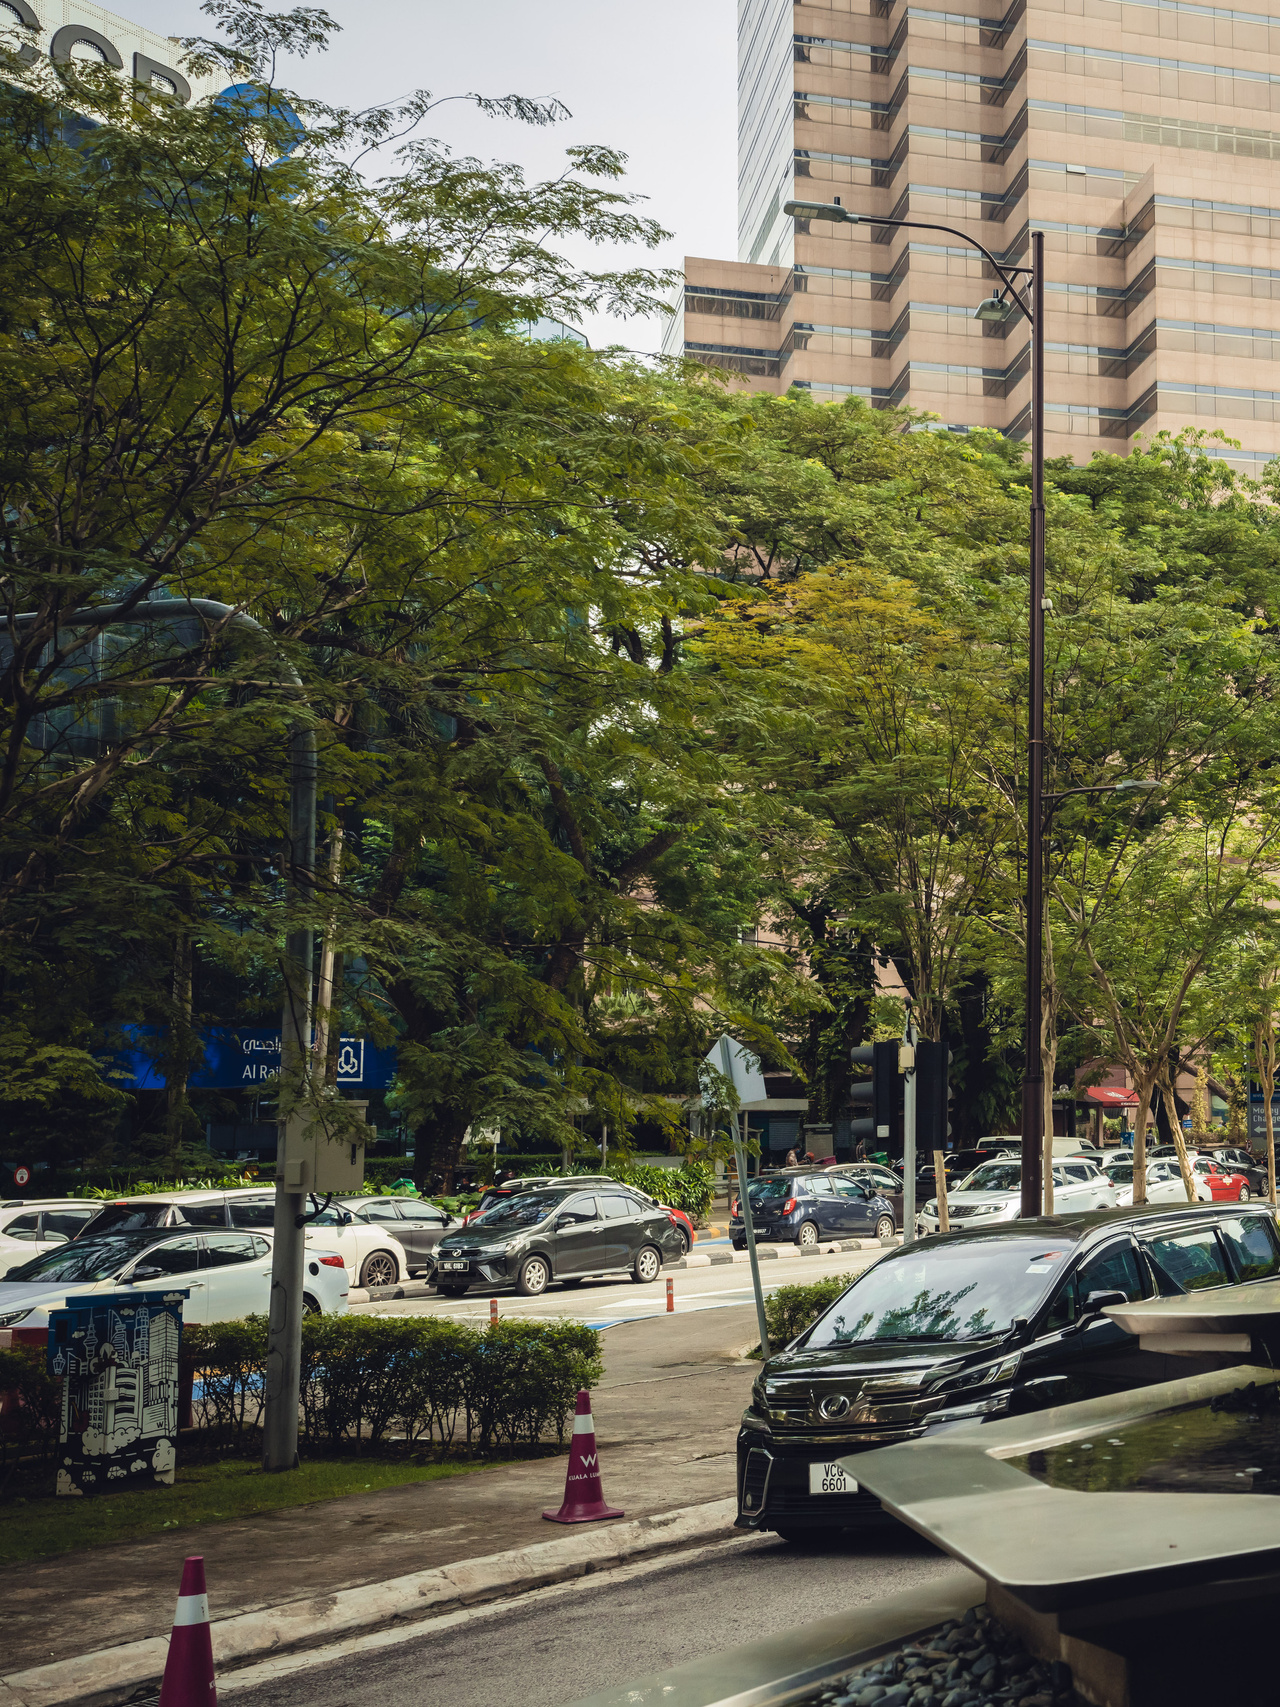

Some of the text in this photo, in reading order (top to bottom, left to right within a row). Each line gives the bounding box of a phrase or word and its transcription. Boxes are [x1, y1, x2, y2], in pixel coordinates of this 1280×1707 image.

[242, 1064, 256, 1079] Al
[1252, 1107, 1279, 1116] Moey
[156, 1421, 164, 1429] W
[579, 1453, 597, 1468] W
[568, 1473, 588, 1482] KUALA
[823, 1464, 844, 1478] VCQ
[821, 1477, 846, 1492] 6601
